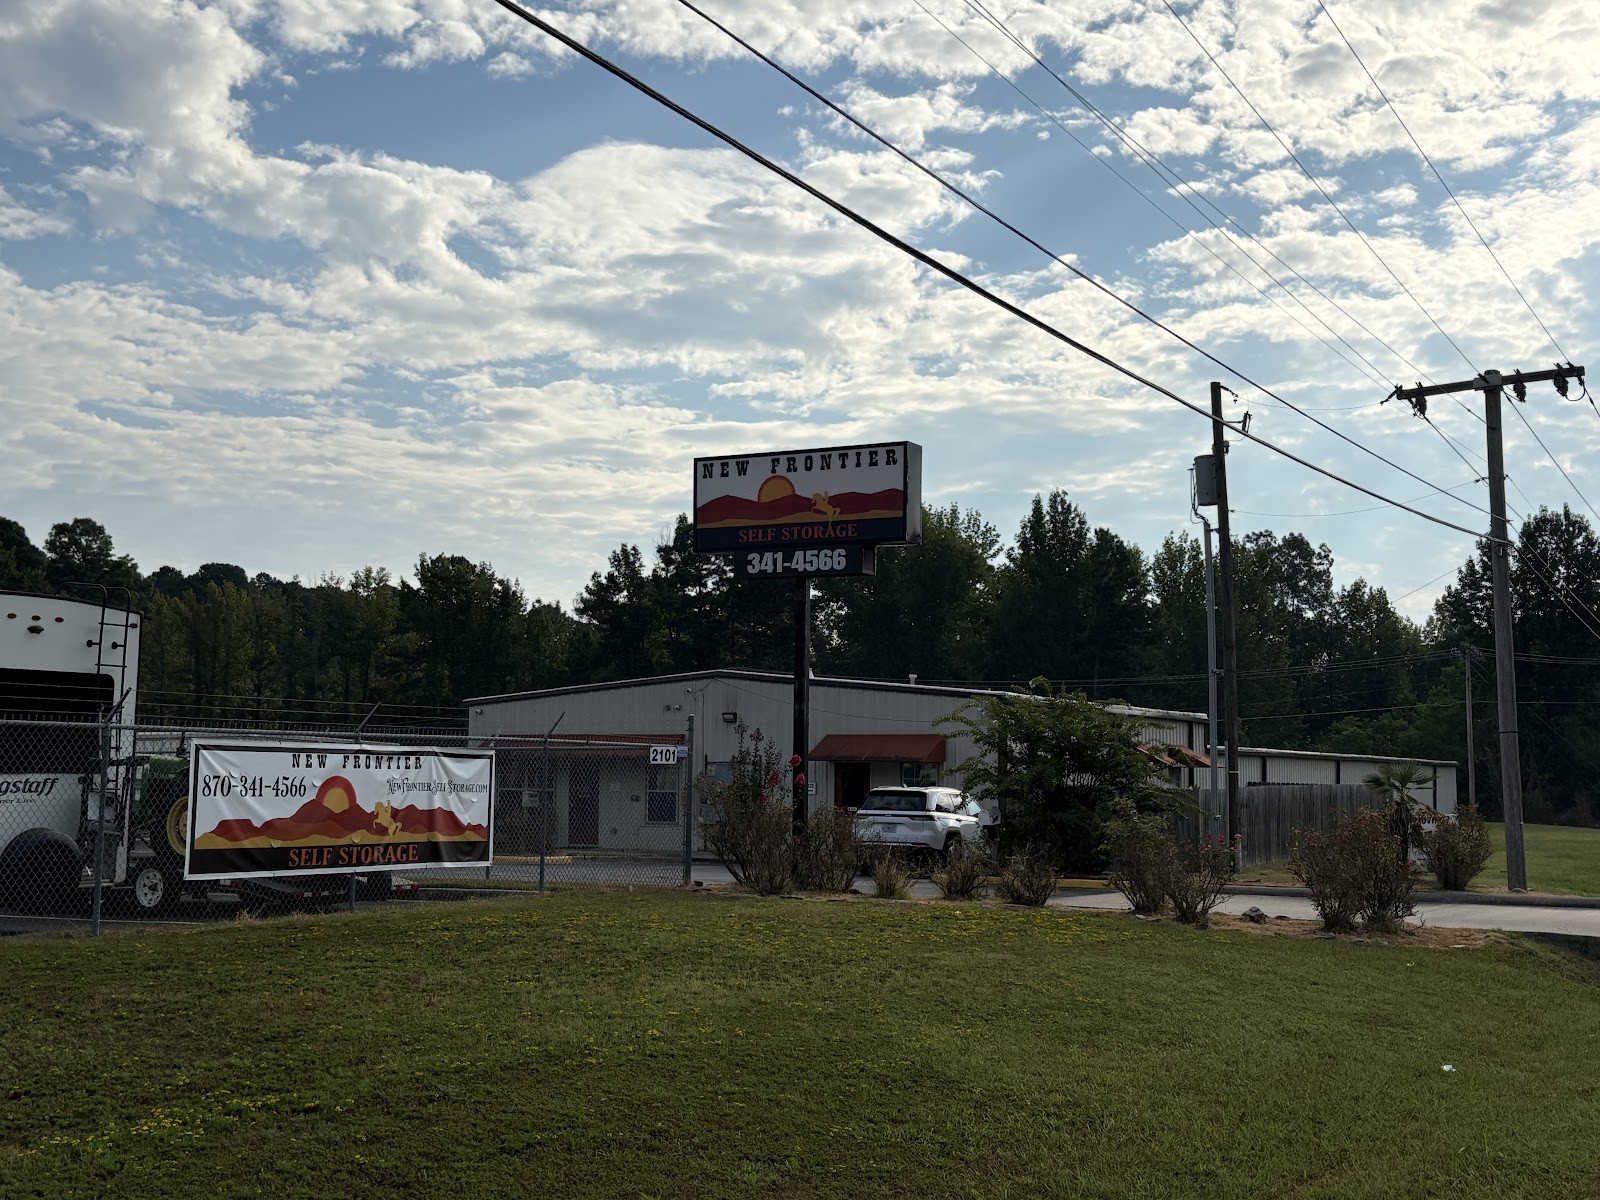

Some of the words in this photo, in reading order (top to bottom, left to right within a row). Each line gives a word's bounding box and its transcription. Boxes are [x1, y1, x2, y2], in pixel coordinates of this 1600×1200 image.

[702, 460, 750, 479] NEW
[770, 449, 898, 474] FRONTIER
[738, 526, 777, 543] SELF
[781, 523, 858, 540] STORAGE
[746, 548, 847, 574] 341-4566
[291, 753, 329, 770] NEW
[342, 753, 423, 770] FRONTIER
[651, 748, 676, 762] 2101
[201, 774, 307, 798] 870-341-4566
[288, 847, 333, 868] SELF
[338, 843, 419, 865] STORAGE
